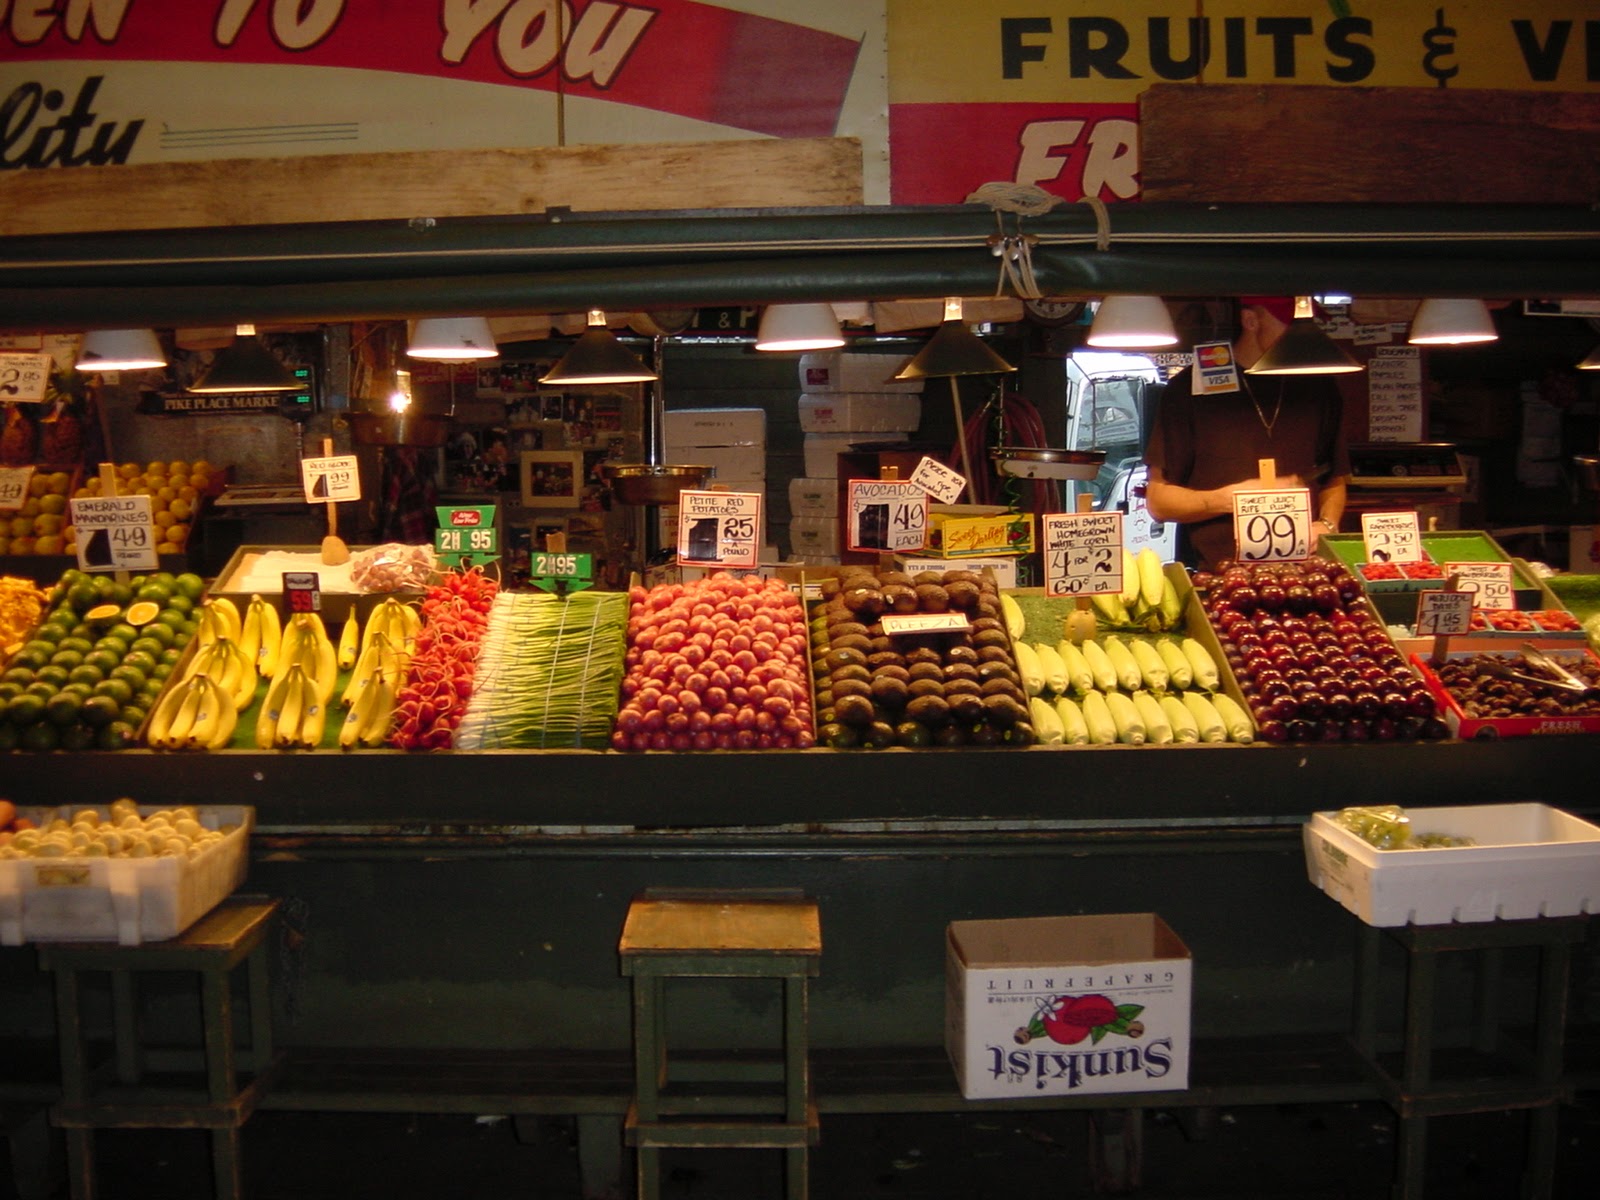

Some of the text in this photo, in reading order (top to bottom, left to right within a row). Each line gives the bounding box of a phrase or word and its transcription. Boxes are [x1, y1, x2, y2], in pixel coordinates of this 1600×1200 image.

[438, 0, 660, 90] YOU
[1001, 16, 1373, 83] FRUITS
[1421, 7, 1460, 89] &
[1208, 376, 1229, 385] VISA
[164, 399, 192, 411] PIKE
[194, 398, 229, 409] PLACE
[854, 484, 925, 497] AVOCADOS
[77, 501, 136, 512] EMERALD
[690, 496, 744, 507] PETITE RED
[1241, 503, 1297, 513] RIPE PLUMS
[75, 511, 149, 523] MANDARINES
[691, 506, 740, 515] POTATOES
[894, 503, 925, 530] 49
[724, 518, 754, 538] 25
[1049, 516, 1116, 529] FRESH SWEET
[113, 527, 146, 547] 49
[1057, 525, 1116, 539] HOMEGROWN
[1393, 532, 1413, 544] 50
[470, 531, 491, 549] 95
[896, 534, 923, 547] EACH
[1084, 535, 1110, 547] CORN
[723, 548, 750, 556] POUND
[1052, 551, 1071, 578] 4
[1484, 583, 1509, 596] 50
[1540, 721, 1581, 729] FRESH
[986, 972, 1174, 990] GRAPEFRUIT
[986, 1039, 1173, 1089] Sunkist
